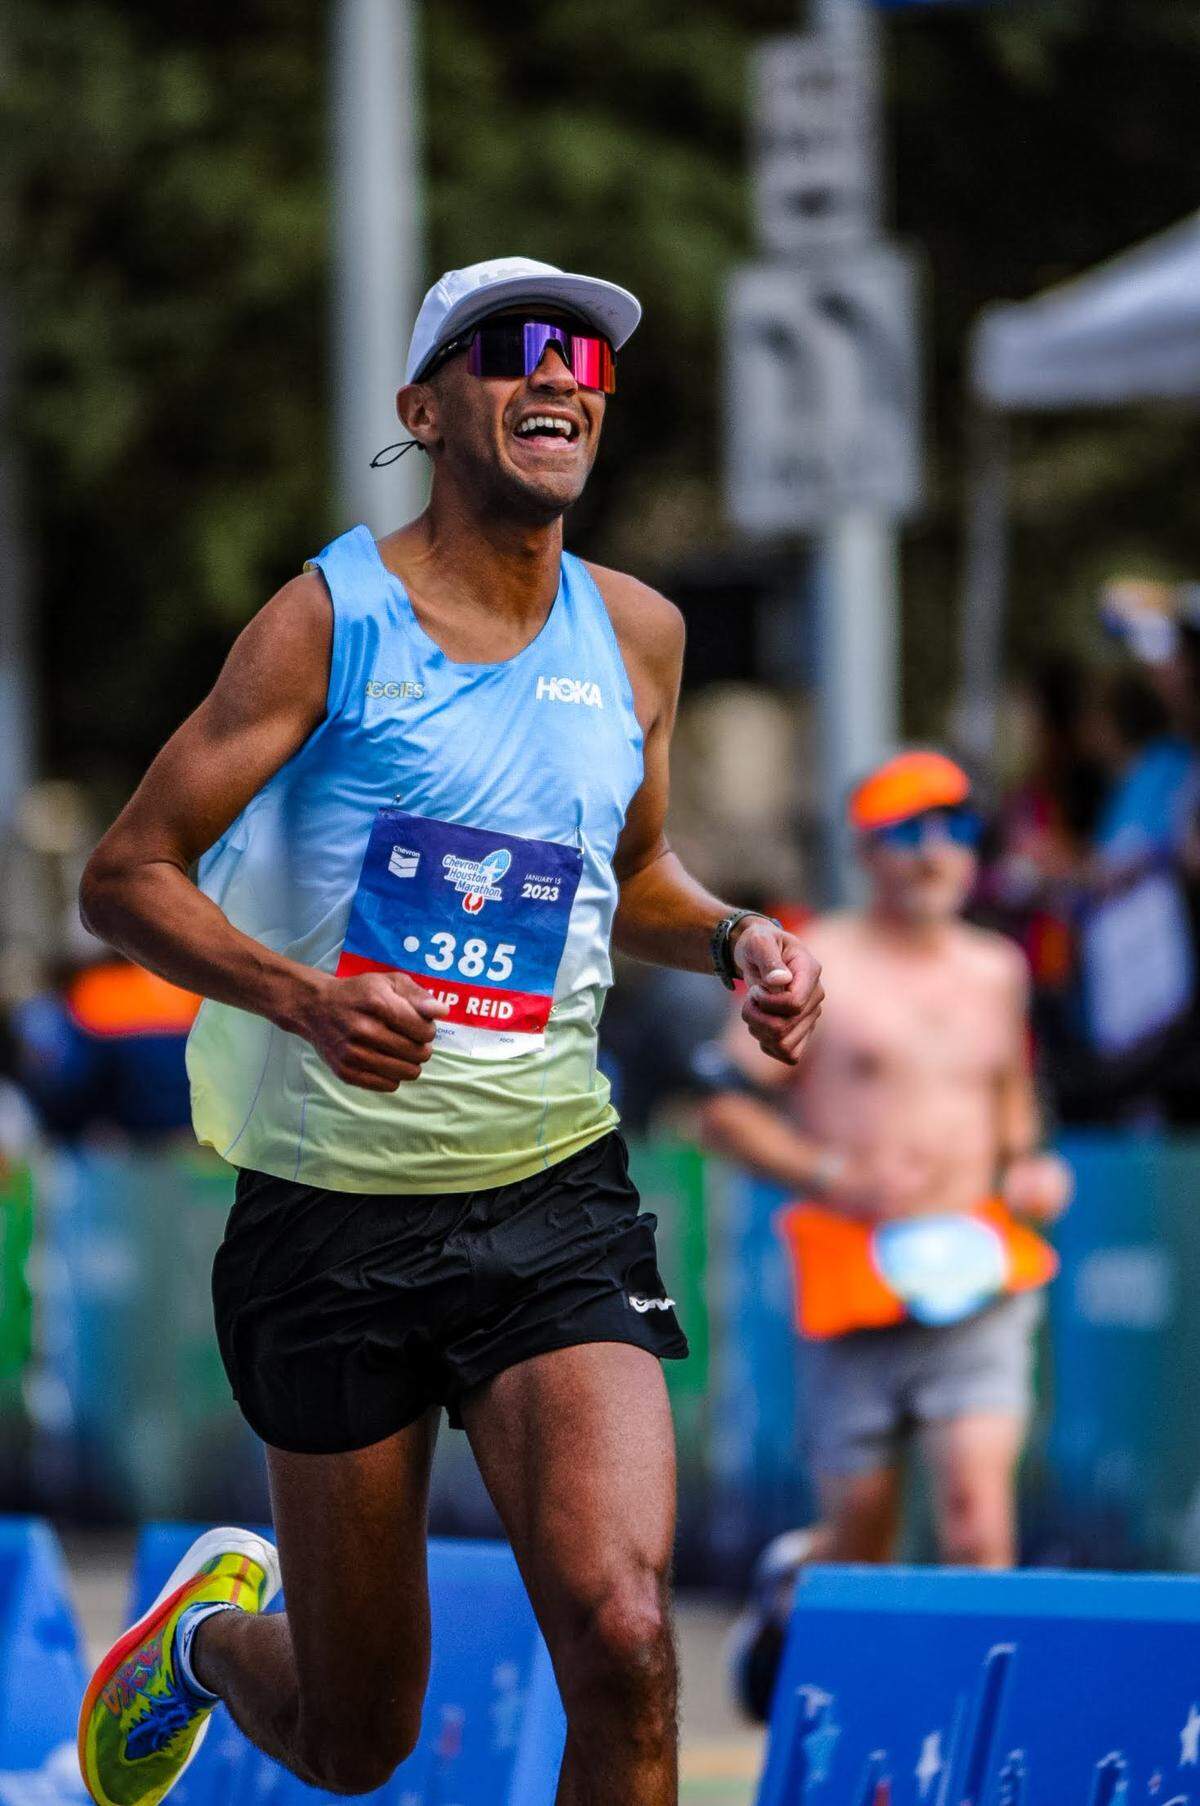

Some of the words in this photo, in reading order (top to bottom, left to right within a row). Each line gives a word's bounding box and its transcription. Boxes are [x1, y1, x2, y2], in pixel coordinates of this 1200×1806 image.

[536, 676, 603, 709] HOKA
[393, 845, 420, 858] Chevron
[444, 855, 480, 872] Chevron
[449, 868, 488, 883] Houston
[524, 873, 553, 884] JANUARY
[456, 881, 501, 898] Marathon
[521, 883, 560, 901] 2023
[424, 932, 517, 982] 385
[465, 997, 514, 1019] REID
